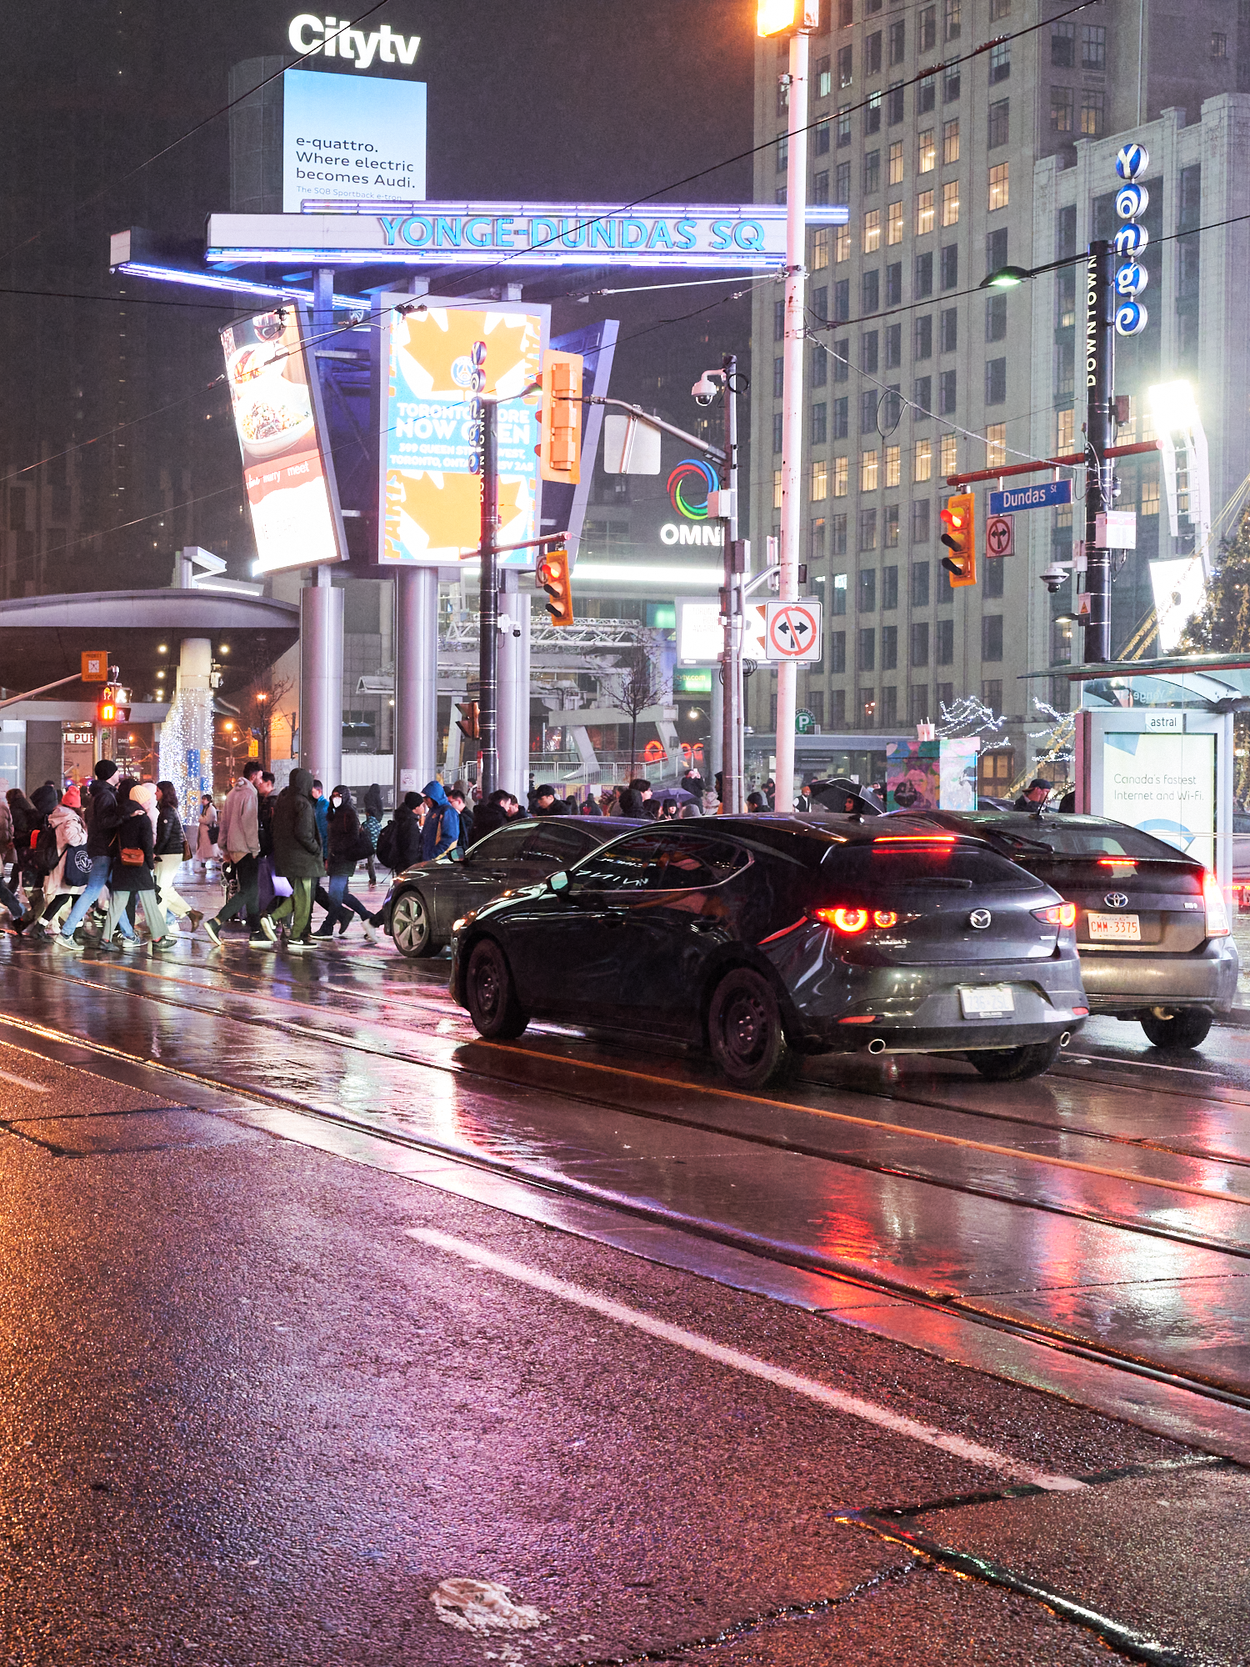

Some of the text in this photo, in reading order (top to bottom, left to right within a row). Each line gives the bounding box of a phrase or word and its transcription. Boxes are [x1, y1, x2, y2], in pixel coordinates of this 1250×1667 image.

[288, 13, 421, 69] Citytv
[296, 137, 378, 153] e-quattro.
[296, 151, 414, 172] Where electric
[296, 167, 416, 188] becomes Audi.
[296, 186, 312, 194] The
[314, 187, 331, 195] SQ8
[333, 188, 375, 199] Sportback
[377, 217, 766, 252] YONGE-DUNDAS SQ
[1086, 254, 1098, 388] DOWNTOWN
[395, 417, 531, 445] NOW OEN
[287, 461, 310, 476] meet
[1003, 484, 1057, 508] Dundas St
[1150, 717, 1177, 728] astral
[1114, 773, 1197, 786] Canada's fastest
[1114, 789, 1205, 802] Internet and Wi-Fi.
[1090, 921, 1138, 934] CMM-3375
